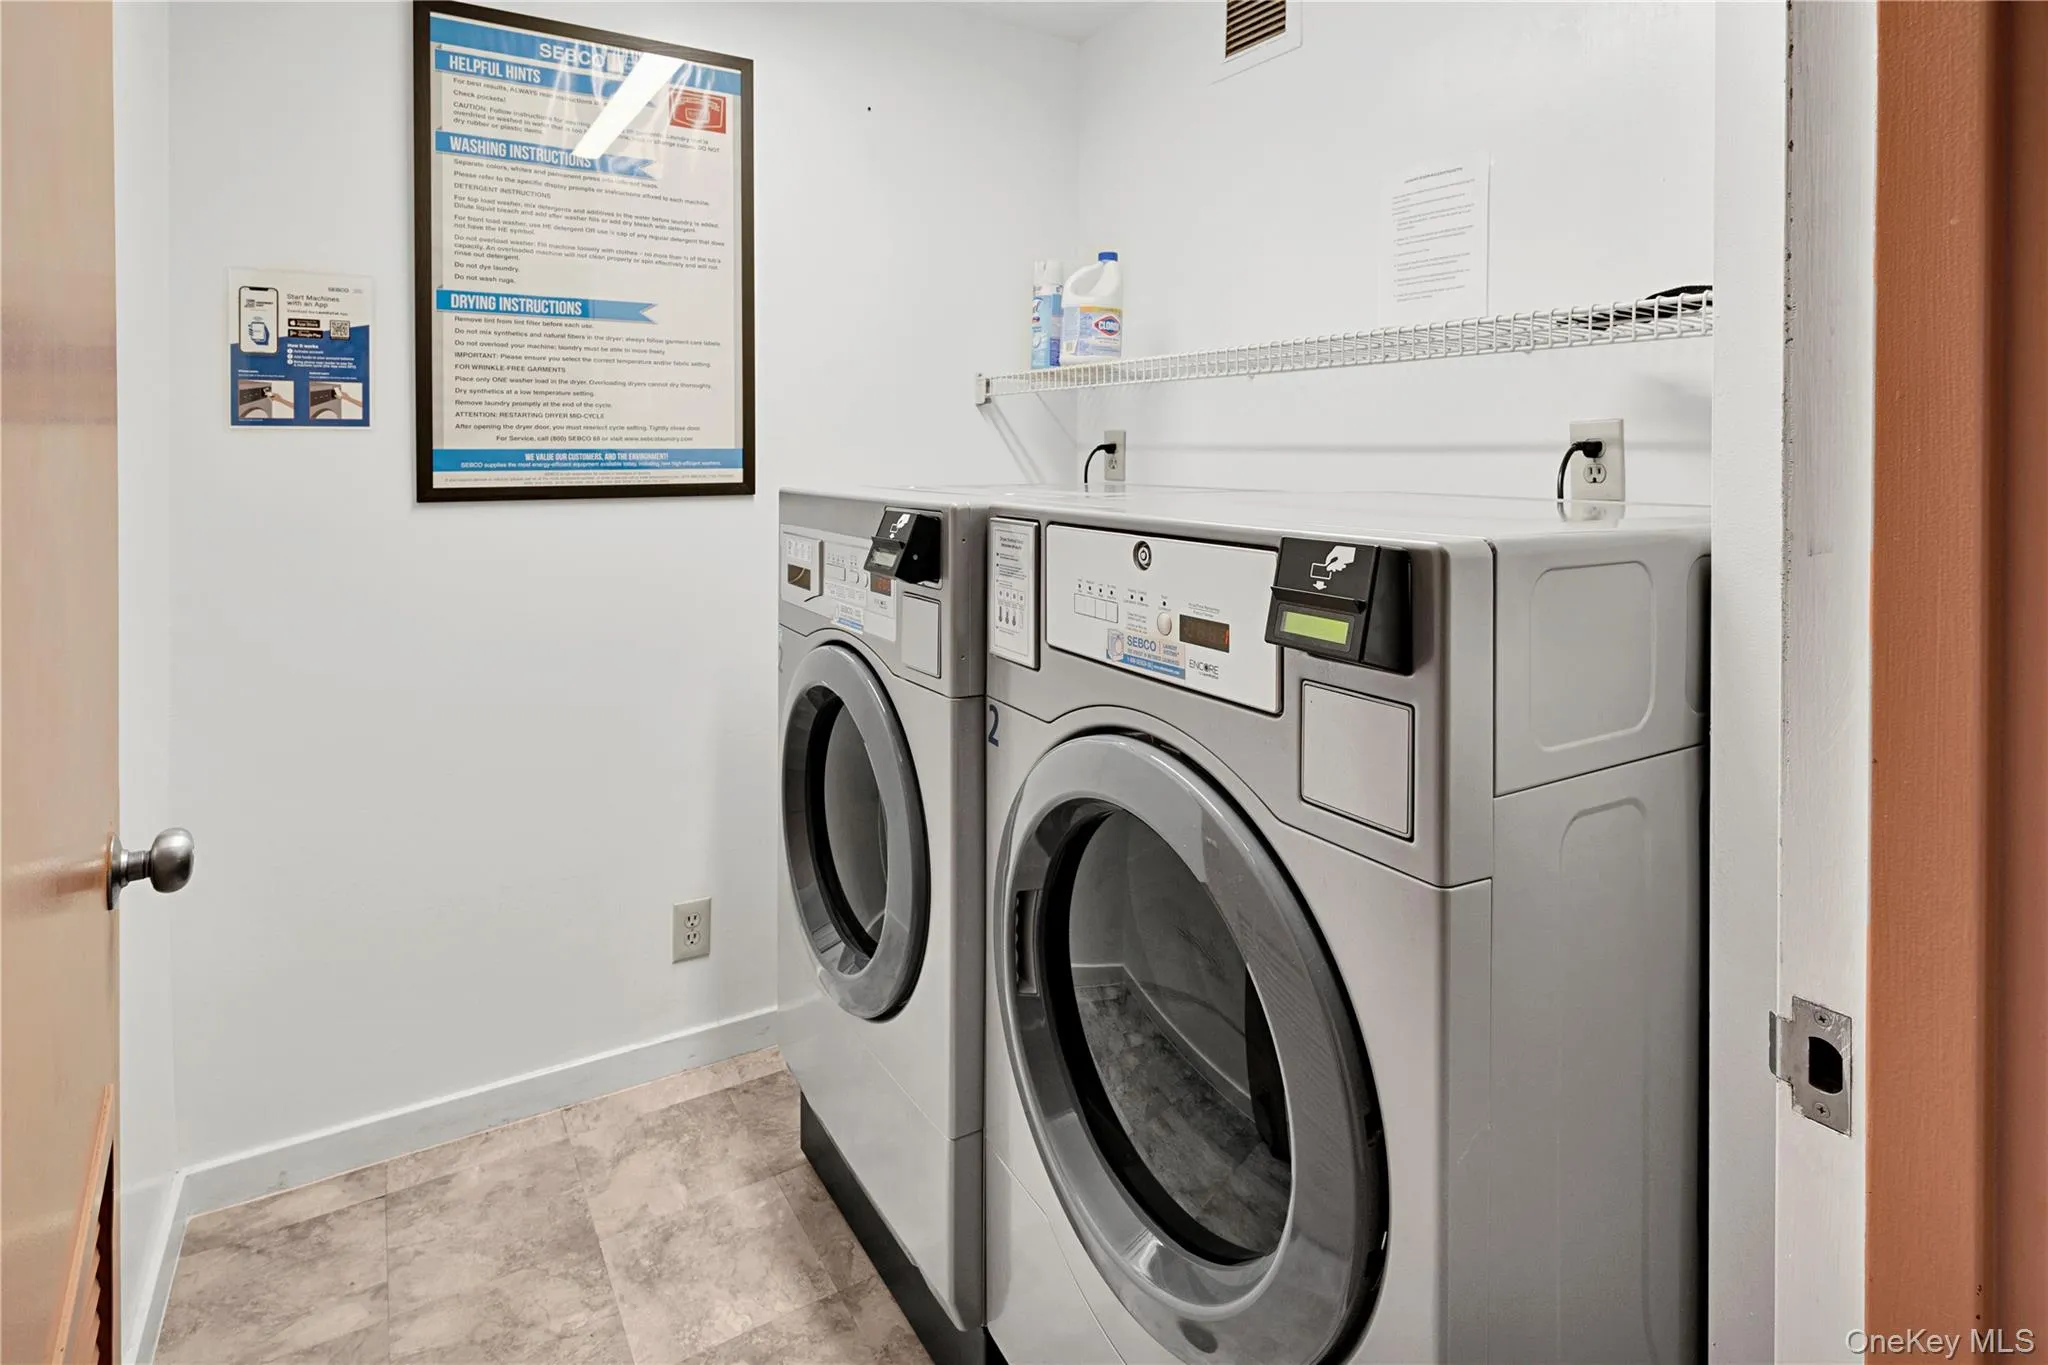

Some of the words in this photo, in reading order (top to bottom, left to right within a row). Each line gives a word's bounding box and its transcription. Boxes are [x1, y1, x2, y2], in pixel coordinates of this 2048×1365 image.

[539, 42, 604, 68] SEBCO
[450, 54, 503, 78] HELPFUL
[506, 64, 540, 84] HINTS
[467, 79, 481, 87] best
[453, 89, 474, 98] Check
[450, 135, 506, 157] WASHING
[510, 144, 591, 168] INSTRUCTIONS
[454, 181, 498, 193] DETERGENT
[500, 187, 551, 199] INSTRUCTIONS
[306, 294, 340, 303] Machines
[315, 301, 328, 309] App
[451, 293, 496, 310] DRYING
[500, 296, 581, 315] INSTRUCTIONS
[454, 315, 482, 323] Remove
[469, 388, 504, 396] synthetics
[484, 400, 510, 408] laundry
[536, 453, 554, 461] VALUE
[1127, 634, 1156, 653] SEBCO
[1189, 659, 1219, 676] ENCORE
[988, 703, 999, 747] 2
